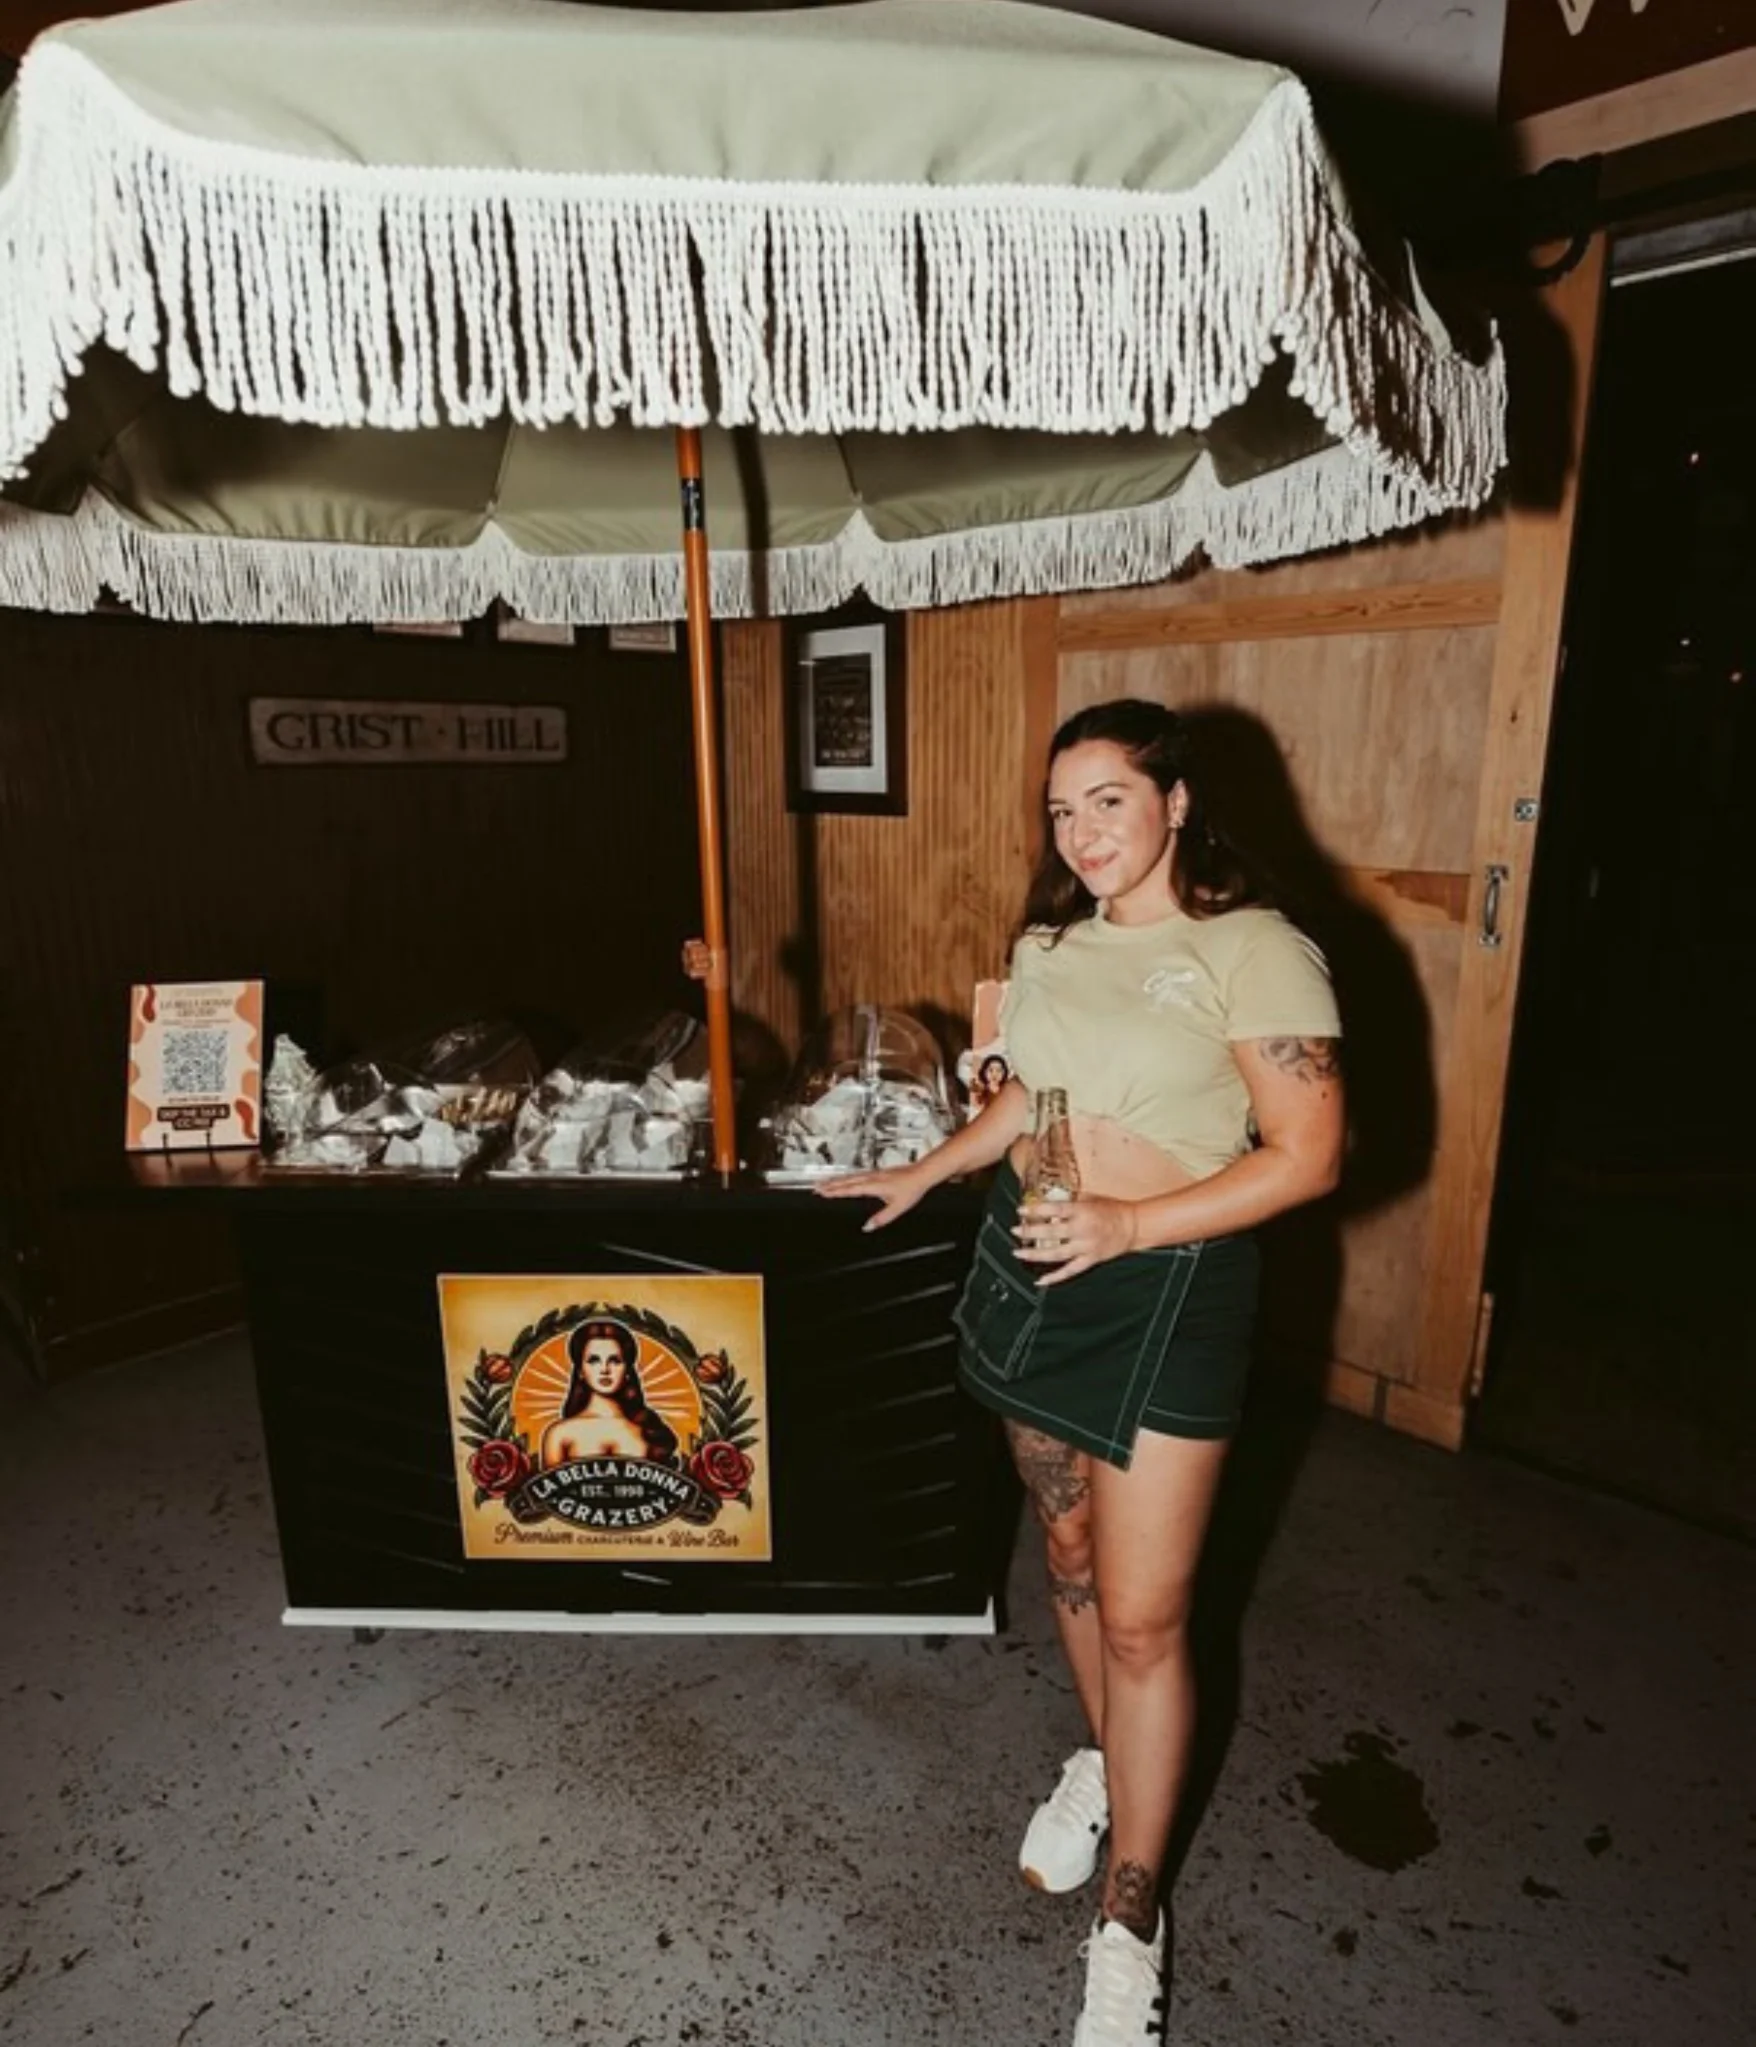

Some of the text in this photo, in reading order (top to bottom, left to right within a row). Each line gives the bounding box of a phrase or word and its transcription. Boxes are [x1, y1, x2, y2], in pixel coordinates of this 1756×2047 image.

[266, 711, 424, 750] GRIST
[532, 1462, 690, 1499] LA BELLA DONNA
[558, 1495, 671, 1527] GRAZERY
[494, 1522, 574, 1546] Premium
[667, 1529, 705, 1548] Wine
[707, 1528, 740, 1548] Bar
